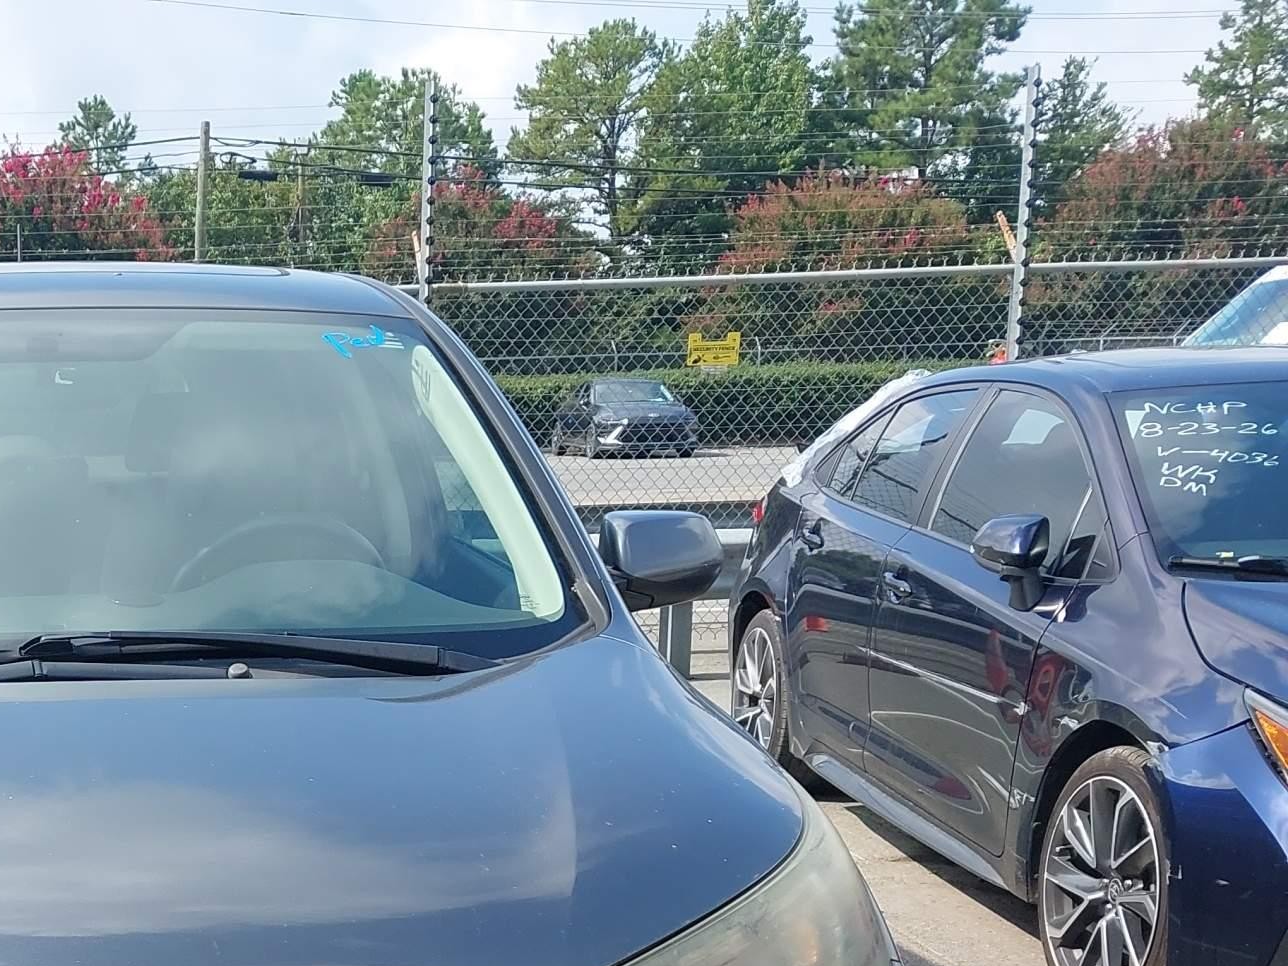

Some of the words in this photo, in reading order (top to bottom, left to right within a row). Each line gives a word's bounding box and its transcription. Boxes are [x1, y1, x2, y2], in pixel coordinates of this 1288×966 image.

[1139, 422, 1279, 437] 8-23-26
[1161, 462, 1219, 483] WK
[1159, 476, 1207, 496] DM
